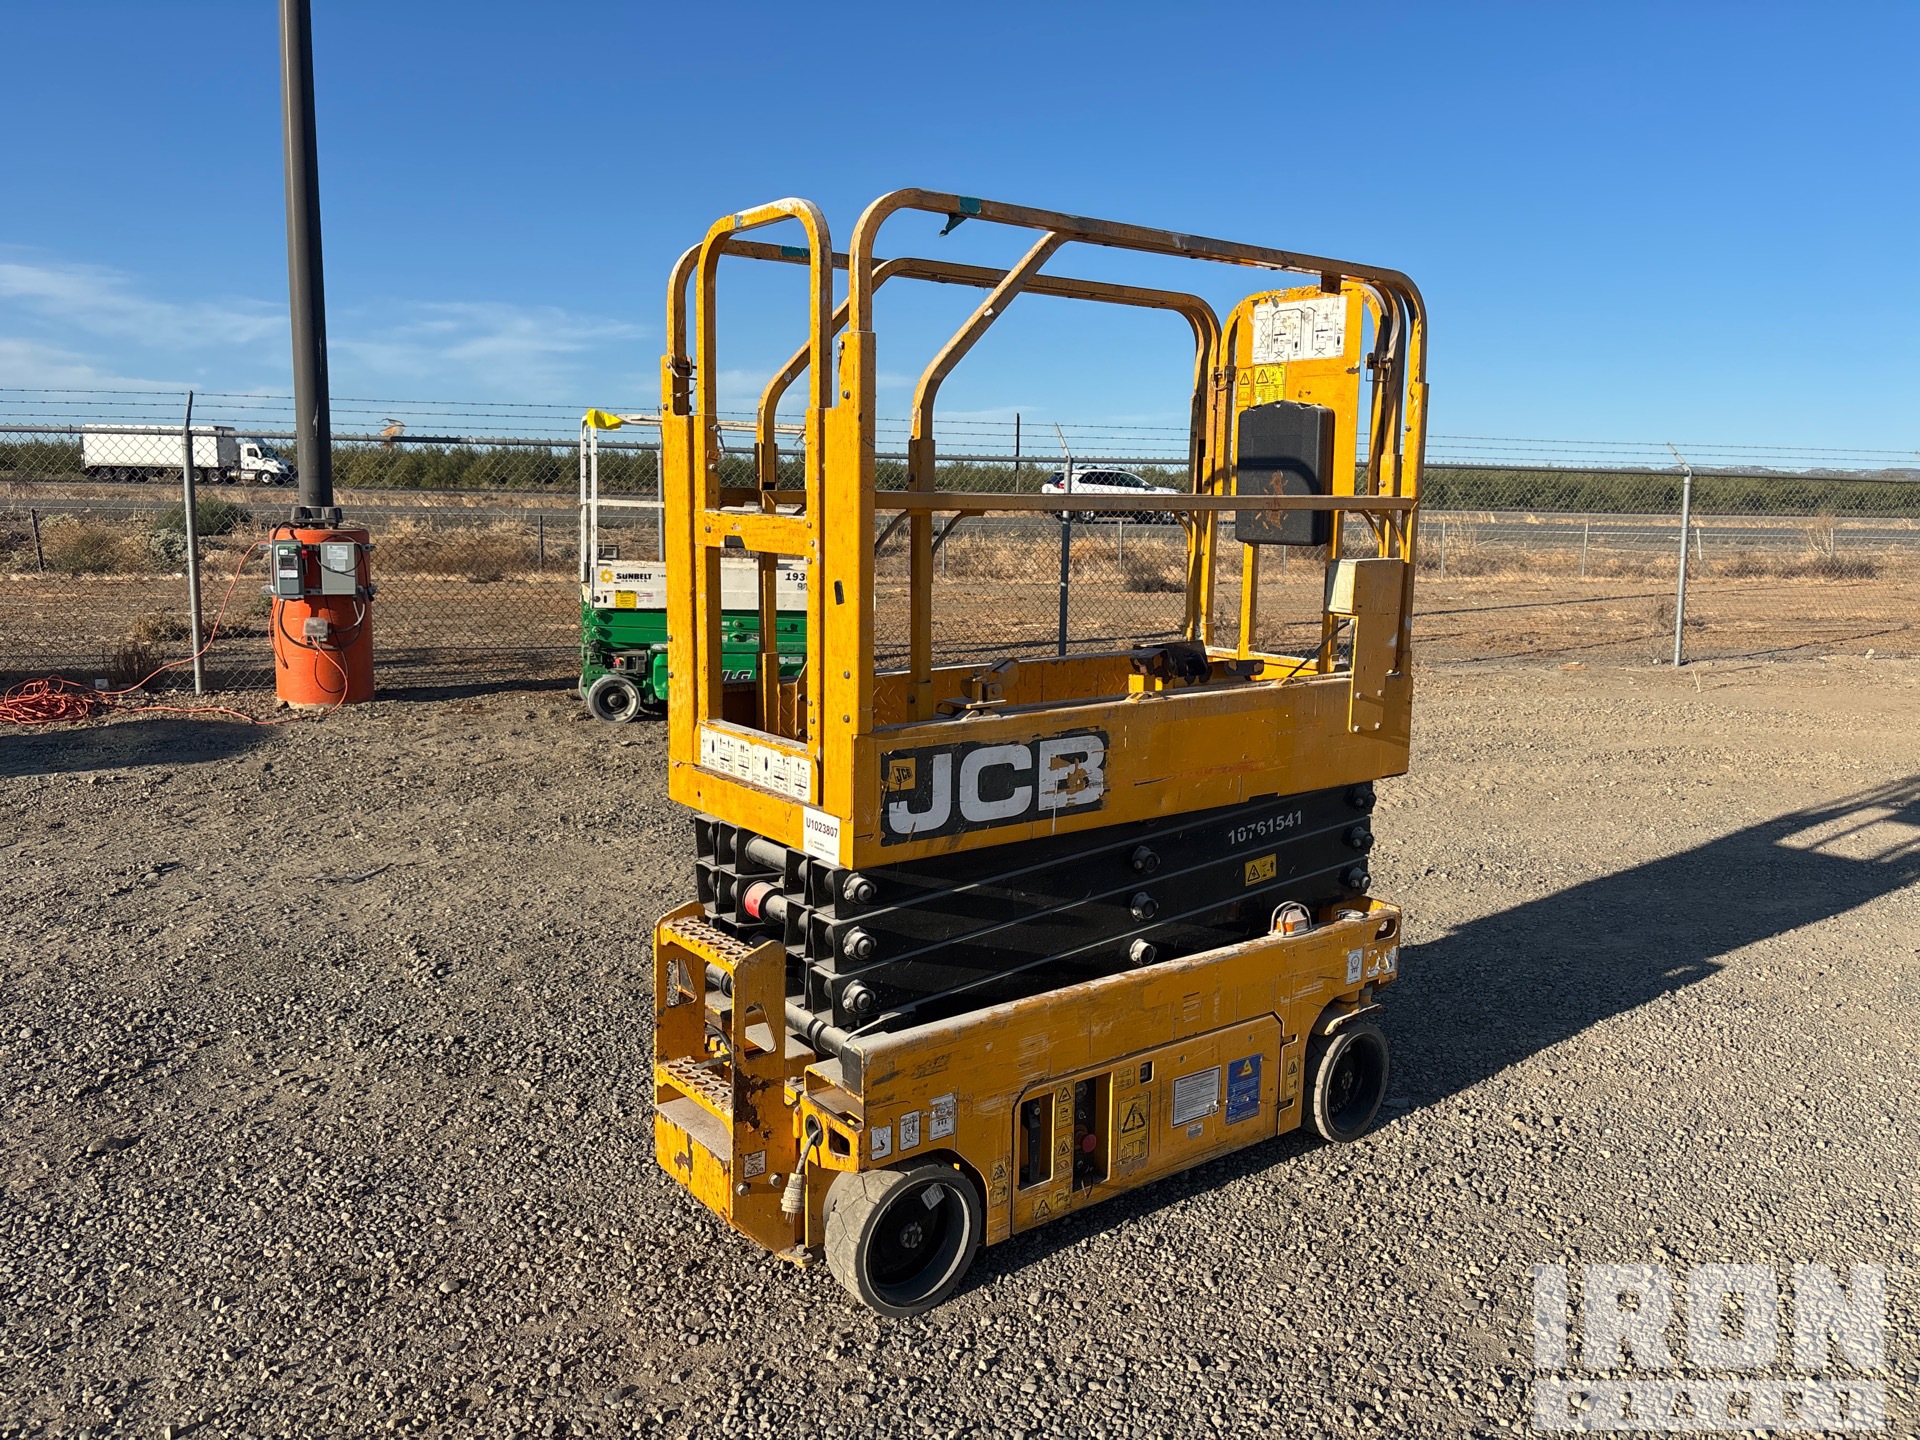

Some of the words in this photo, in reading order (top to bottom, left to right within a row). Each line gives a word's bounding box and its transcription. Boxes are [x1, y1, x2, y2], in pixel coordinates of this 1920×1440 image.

[616, 572, 653, 580] SUNBELT
[785, 572, 808, 581] 193
[896, 767, 912, 783] JCB
[888, 734, 1105, 835] JCB
[806, 817, 838, 838] U1023807
[1228, 809, 1303, 845] 10761541
